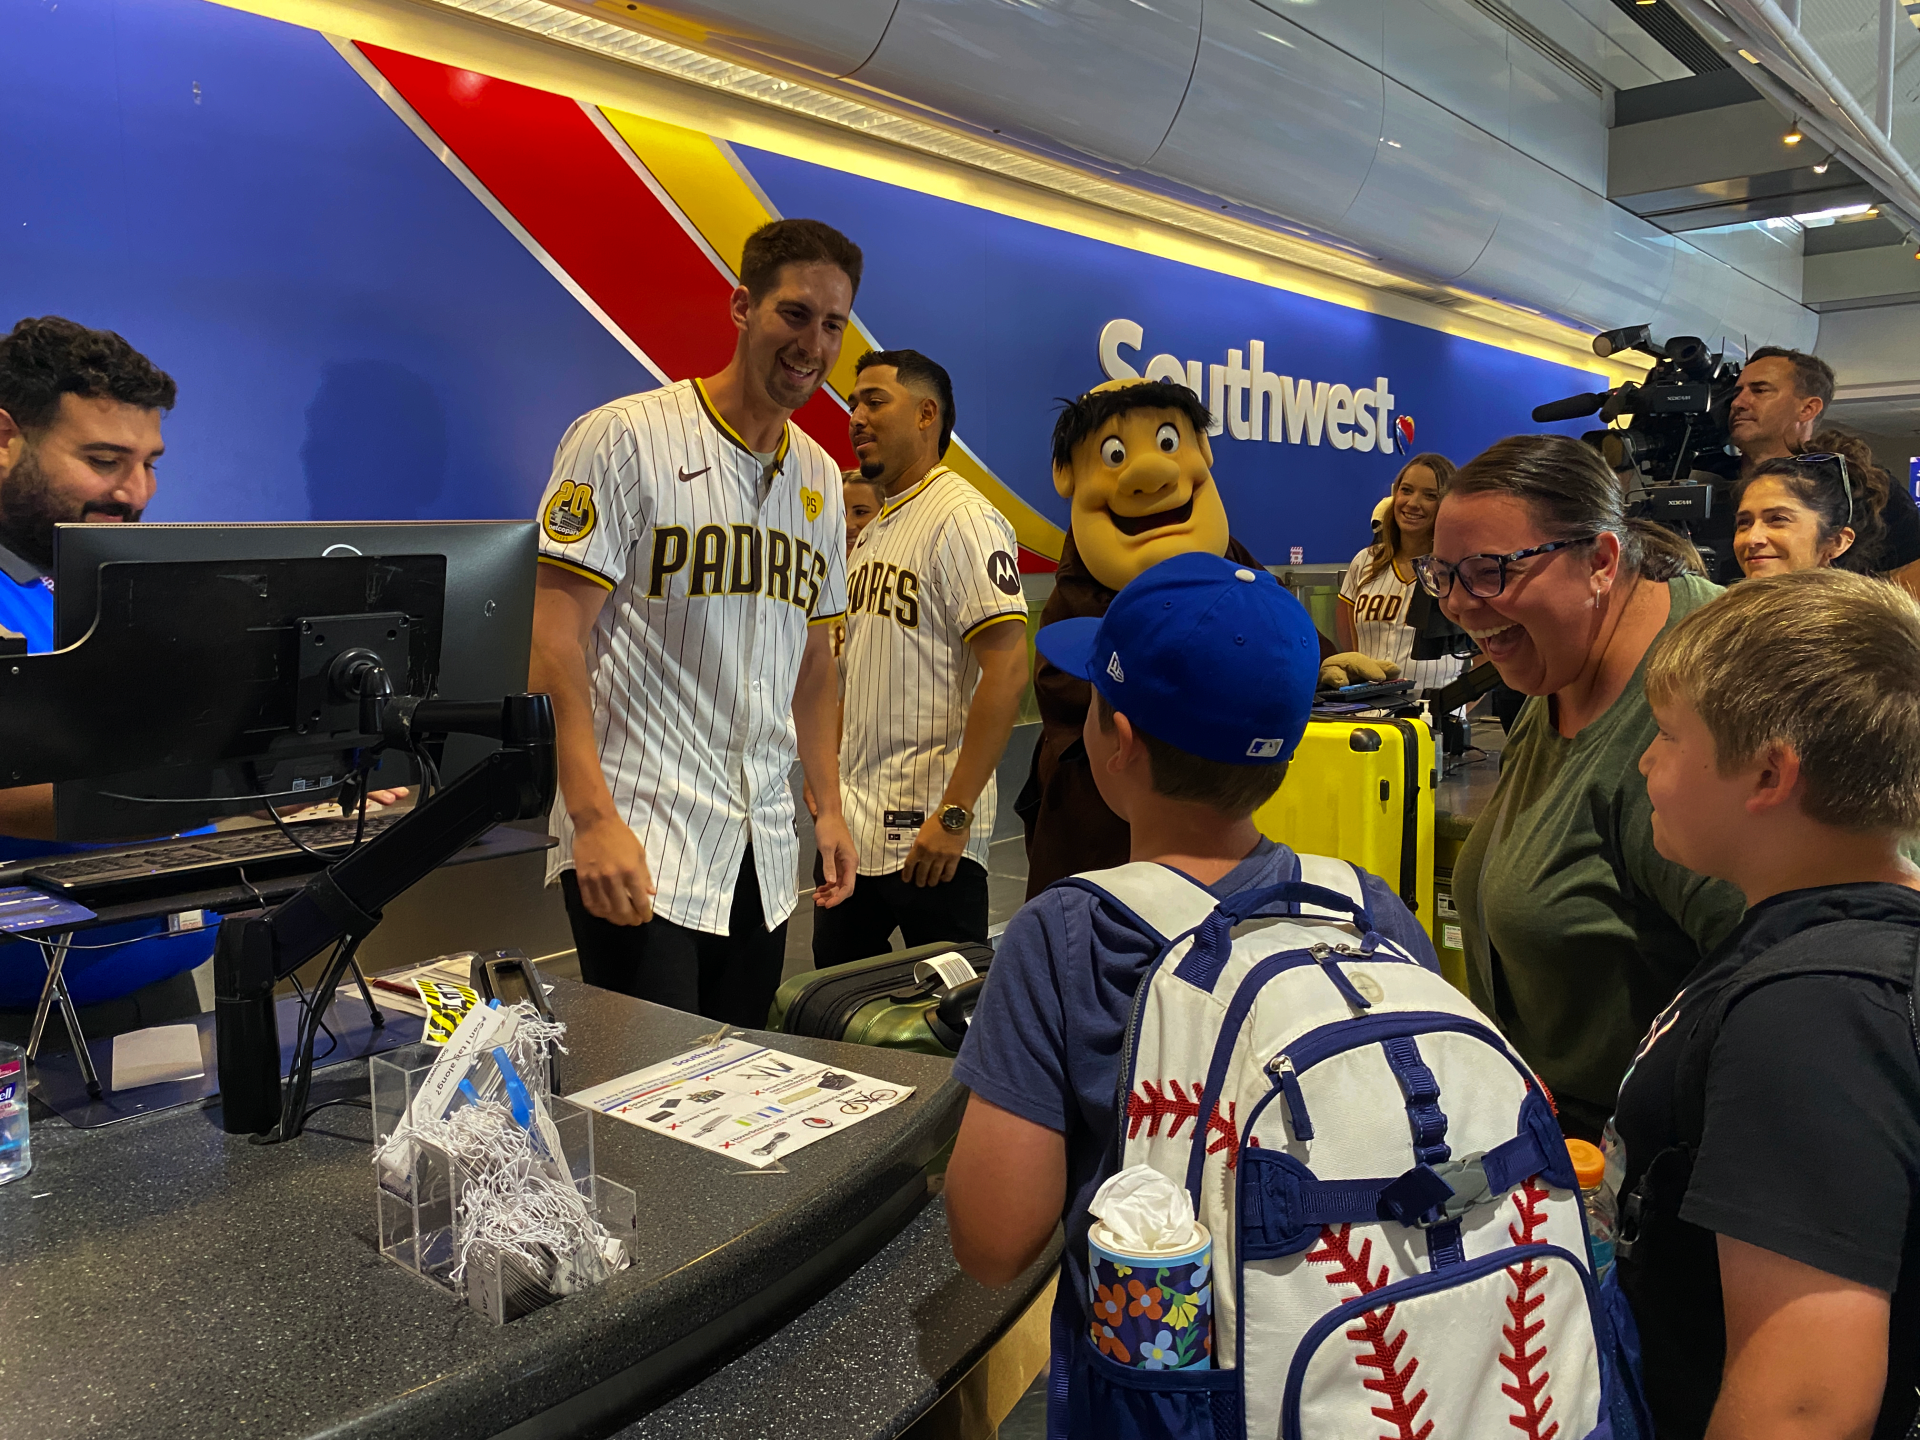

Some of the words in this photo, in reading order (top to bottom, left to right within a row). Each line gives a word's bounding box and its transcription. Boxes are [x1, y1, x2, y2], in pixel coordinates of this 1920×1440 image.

[555, 480, 593, 517] 20
[806, 495, 817, 514] PS
[644, 523, 829, 620] PADRES
[1354, 593, 1403, 624] PAD
[672, 1044, 729, 1067] Southwest
